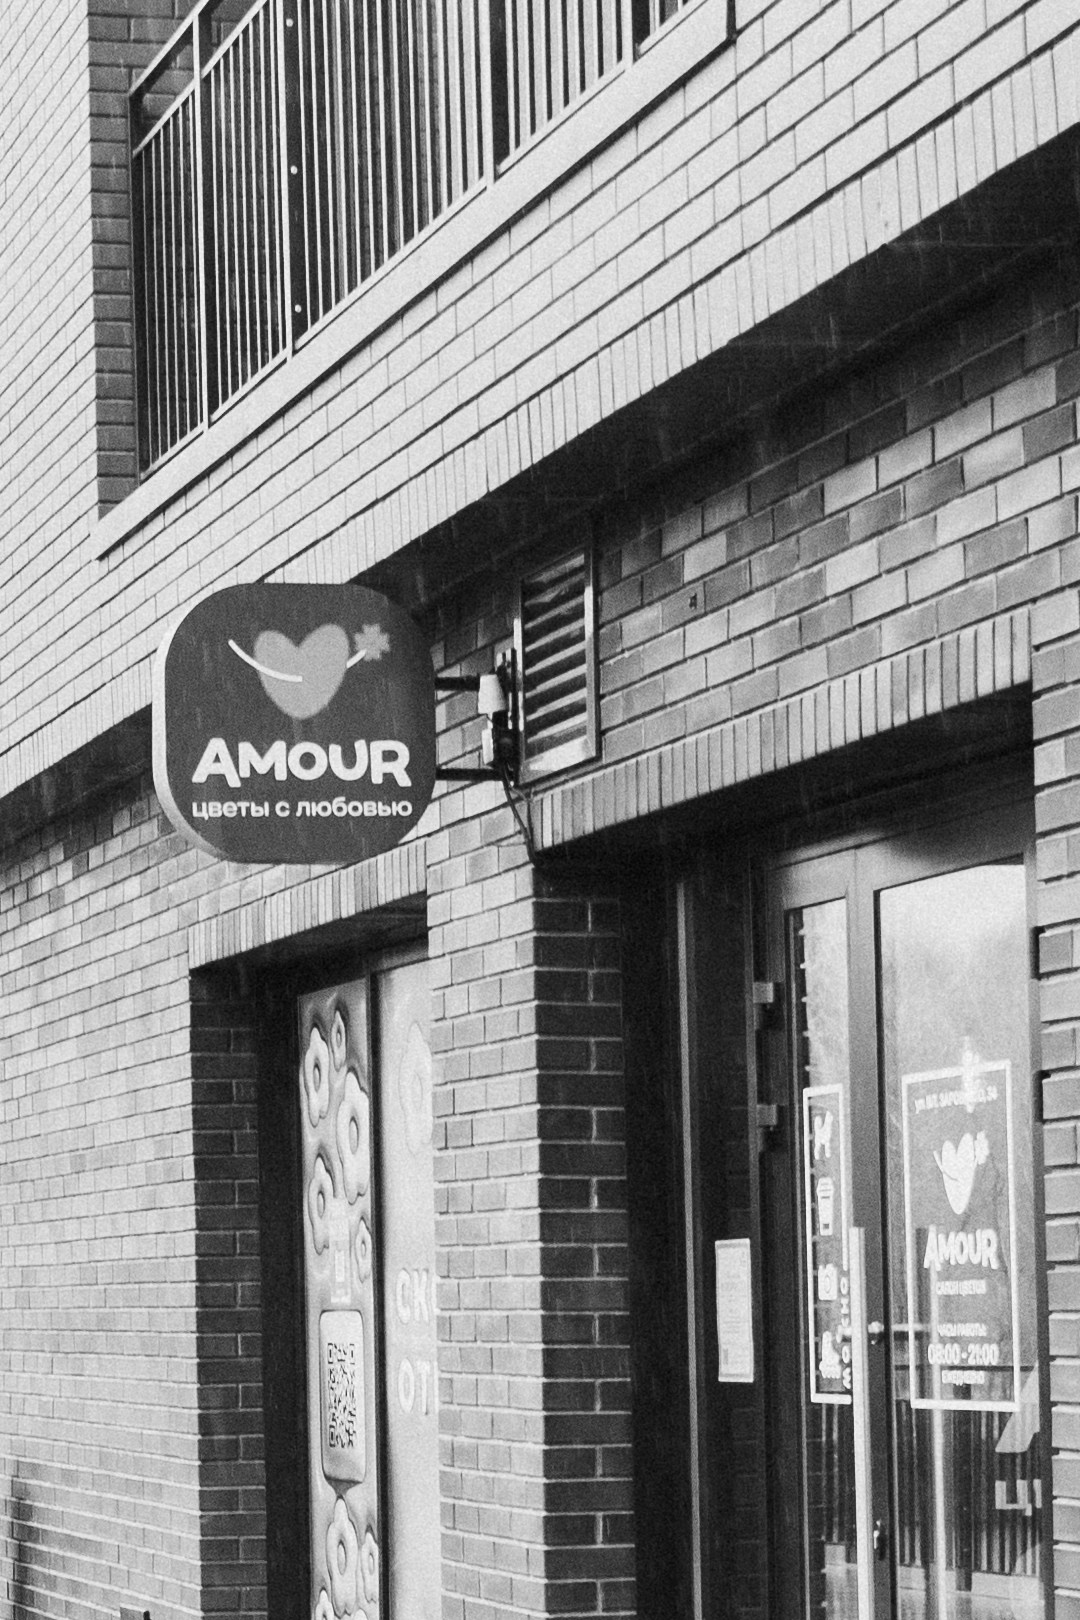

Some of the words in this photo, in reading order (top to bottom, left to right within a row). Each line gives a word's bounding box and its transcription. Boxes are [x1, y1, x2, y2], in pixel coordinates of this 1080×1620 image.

[191, 737, 412, 788] AMOUR
[191, 801, 269, 820] цветы
[275, 802, 290, 818] с
[295, 796, 413, 818] любовью
[923, 1225, 1000, 1272] AMOUR
